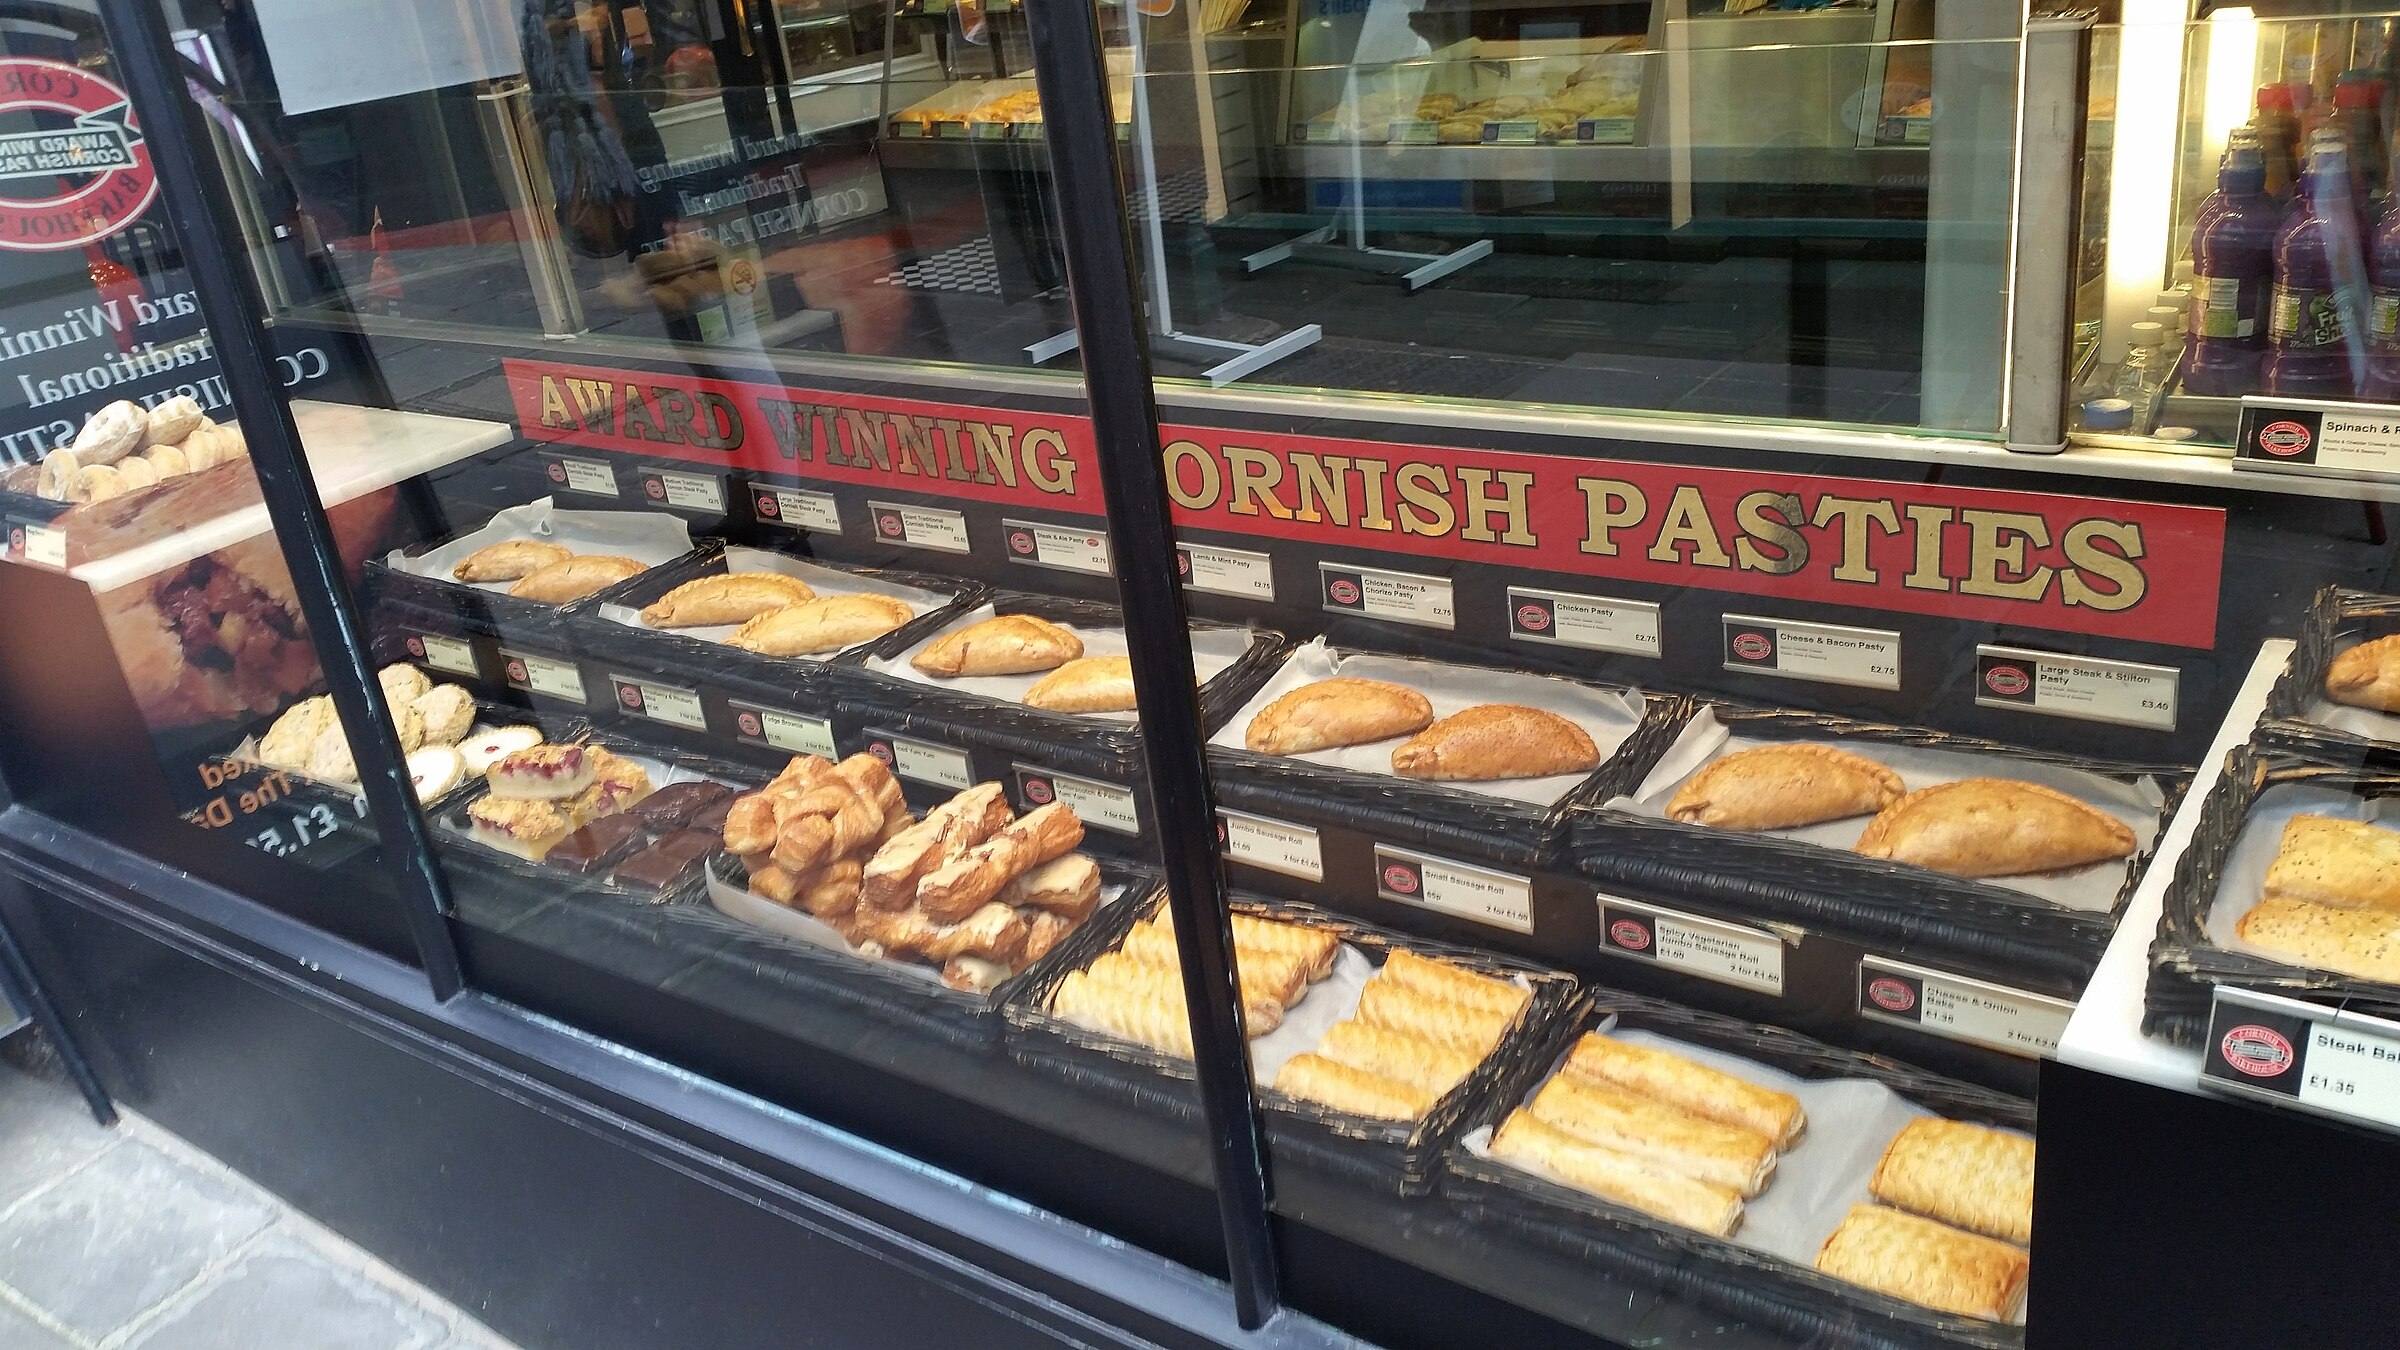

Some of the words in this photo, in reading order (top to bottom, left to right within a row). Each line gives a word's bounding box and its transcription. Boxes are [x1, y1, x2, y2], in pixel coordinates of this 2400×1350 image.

[2326, 421, 2377, 434] Spinach
[2381, 424, 2391, 434] &
[539, 374, 746, 452] AWARD
[757, 396, 1078, 495] WINNING
[1161, 440, 1538, 548] ORNISH
[1576, 475, 2149, 612] PASTIES
[812, 506, 826, 515] Pasty
[905, 520, 925, 528] Cornish
[939, 525, 954, 533] Pasty
[1036, 532, 1052, 540] Steak
[1068, 536, 1085, 545] Pasty
[1192, 553, 1211, 561] Lamb
[1217, 556, 1232, 564] Mint
[1232, 559, 1251, 569] Pasty
[1254, 581, 1271, 590] £2.75
[1364, 578, 1395, 589] Chicken,
[1396, 582, 1419, 592] Bacon
[1420, 585, 1426, 593] &
[1365, 586, 1392, 596] Chorizo
[1394, 589, 1414, 600] Pasty
[1433, 607, 1452, 616] £2.75
[1556, 603, 1589, 613] Chicken
[1591, 607, 1614, 618] Pasty
[1635, 633, 1657, 643] £2.75
[1780, 633, 1815, 644] Cheese
[1816, 636, 1824, 645] &
[1826, 638, 1857, 649] Bacon
[1858, 641, 1886, 653] Pasty
[1870, 665, 1895, 675] £2.75
[2040, 664, 2070, 676] Large
[2072, 668, 2103, 679] Steak
[2105, 671, 2113, 680] &
[2116, 673, 2151, 685] Stilton
[2040, 674, 2070, 686] Pasty
[2141, 700, 2169, 711] £3.40
[1231, 823, 1255, 834] Jumbo
[1256, 828, 1287, 841] Sausage
[1288, 834, 1304, 846] Roll
[1289, 856, 1300, 864] for
[1425, 870, 1448, 881] Small
[1449, 876, 1485, 892] Sausage
[1487, 884, 1505, 896] Roll
[1485, 905, 1491, 913] 2
[1492, 906, 1505, 916] for
[1658, 925, 1687, 939] Spicy
[1688, 931, 1741, 950] Vegetarian
[1658, 935, 1692, 948] Jumbo
[1694, 941, 1738, 960] Sausage
[1739, 950, 1760, 965] Roll
[1729, 965, 1736, 973] 2
[1738, 966, 1752, 976] for
[1926, 996, 1955, 1010] Bake
[1927, 986, 1970, 1003] Cheese
[1971, 996, 1980, 1006] &
[1983, 1000, 2019, 1016] Onion
[2007, 1031, 2014, 1040] 2
[2016, 1031, 2033, 1044] for
[2317, 1034, 2366, 1056] Steak
[2309, 1074, 2355, 1095] £1.35
